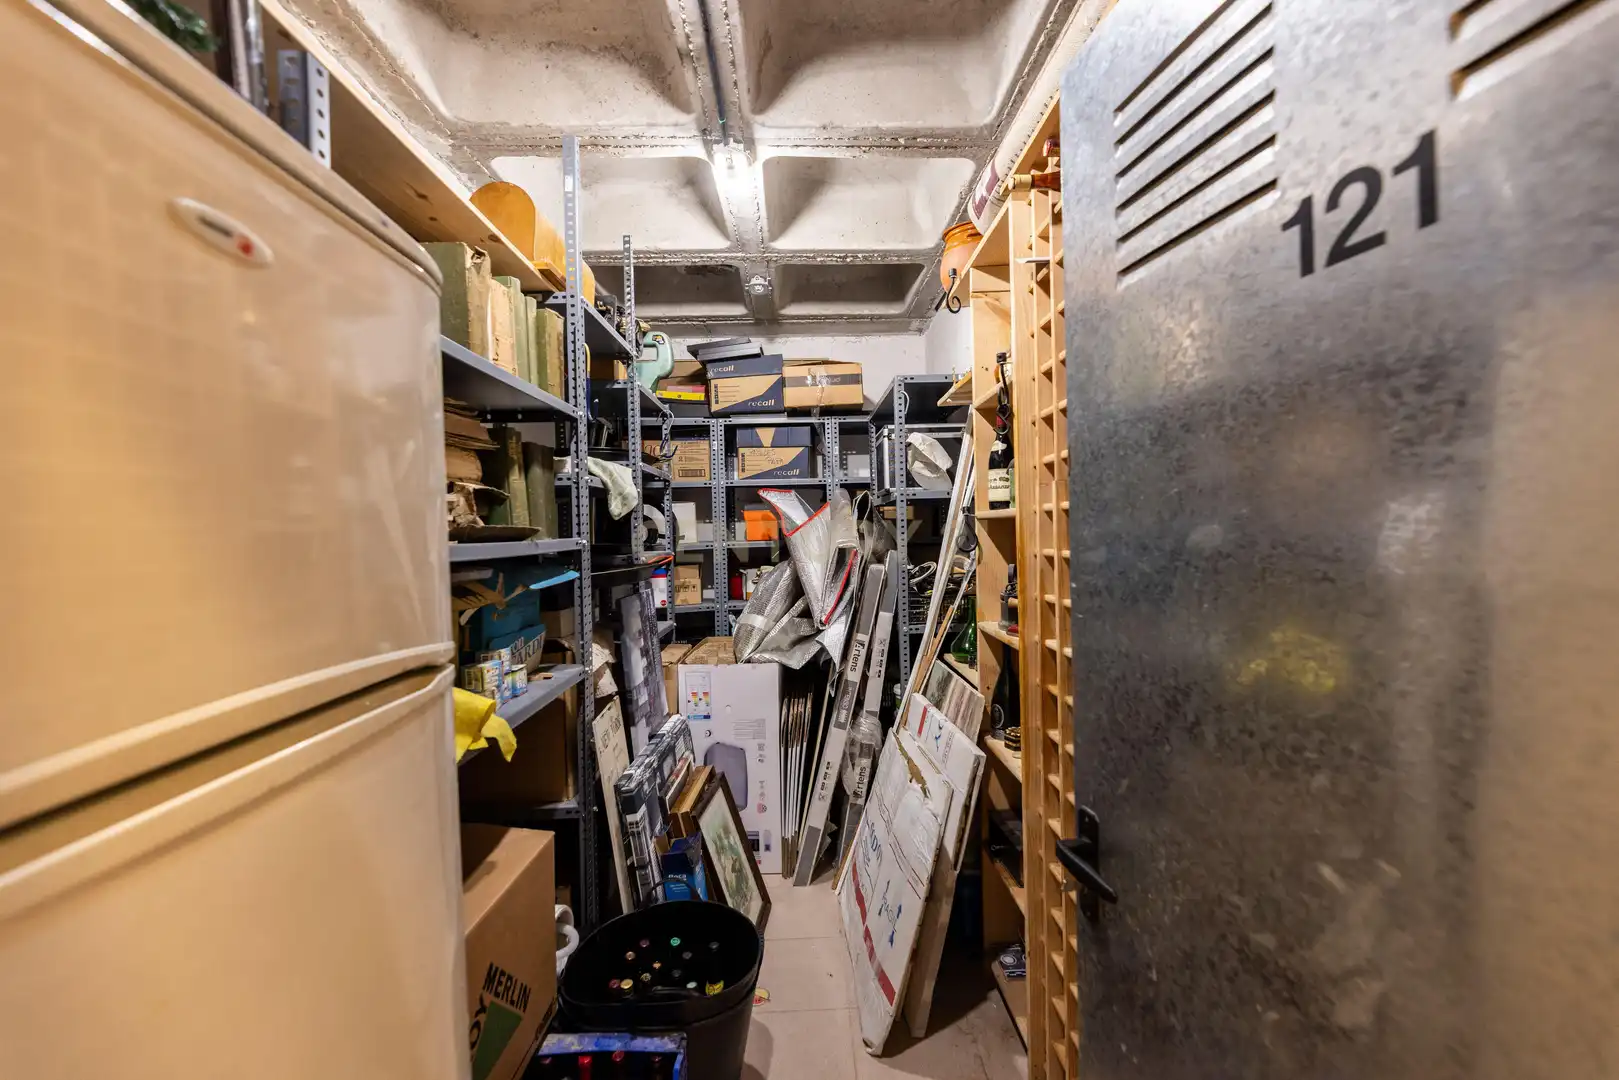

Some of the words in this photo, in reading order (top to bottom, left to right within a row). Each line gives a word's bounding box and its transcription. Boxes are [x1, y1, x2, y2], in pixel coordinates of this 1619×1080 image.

[1281, 128, 1439, 278] 121
[710, 364, 735, 373] recall
[748, 399, 776, 407] recall
[773, 468, 801, 476] recall
[482, 962, 532, 1014] MERLIN
